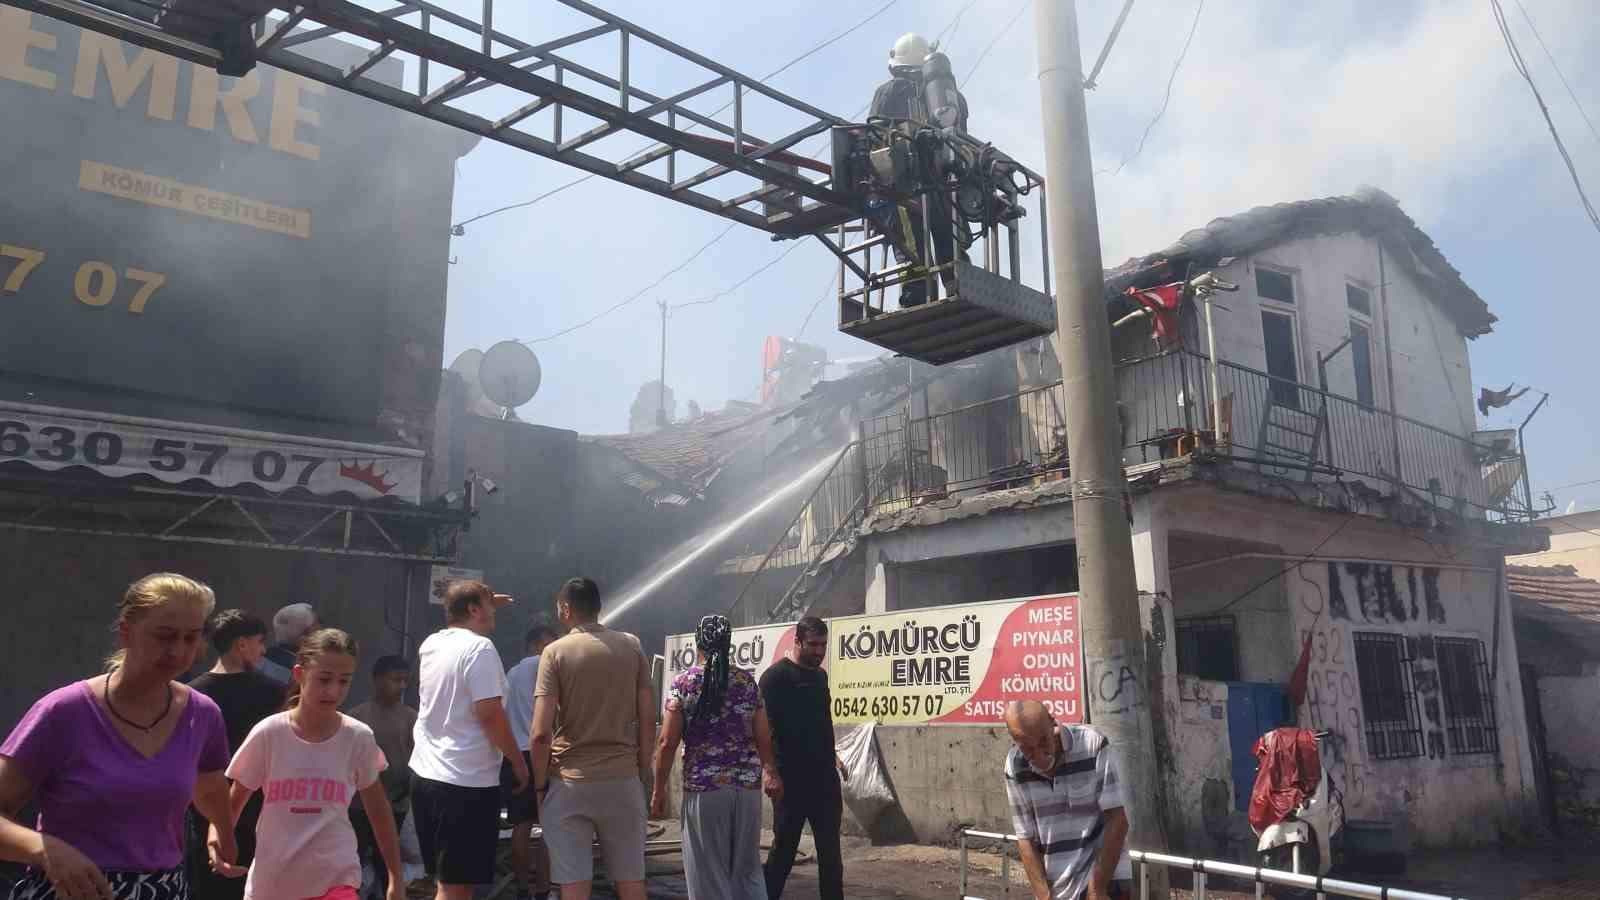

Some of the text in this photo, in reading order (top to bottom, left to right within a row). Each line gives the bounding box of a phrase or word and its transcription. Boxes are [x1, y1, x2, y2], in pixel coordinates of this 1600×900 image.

[0, 5, 326, 160] EMRE
[74, 260, 167, 313] 07
[0, 421, 326, 486] 630 57 07
[1029, 606, 1073, 625] MEŞE
[839, 614, 981, 660] KÖMÜRCÜ
[1013, 629, 1074, 648] PIYNAR
[670, 634, 764, 671] KÖRCÜ
[1023, 653, 1075, 669] ODUN
[891, 655, 971, 687] EMRE
[1001, 672, 1075, 693] KÖMÜRÜ
[834, 694, 944, 717] 0542 630 57 07
[964, 700, 1005, 719] SATIŞ
[266, 777, 347, 805] BOSTON
